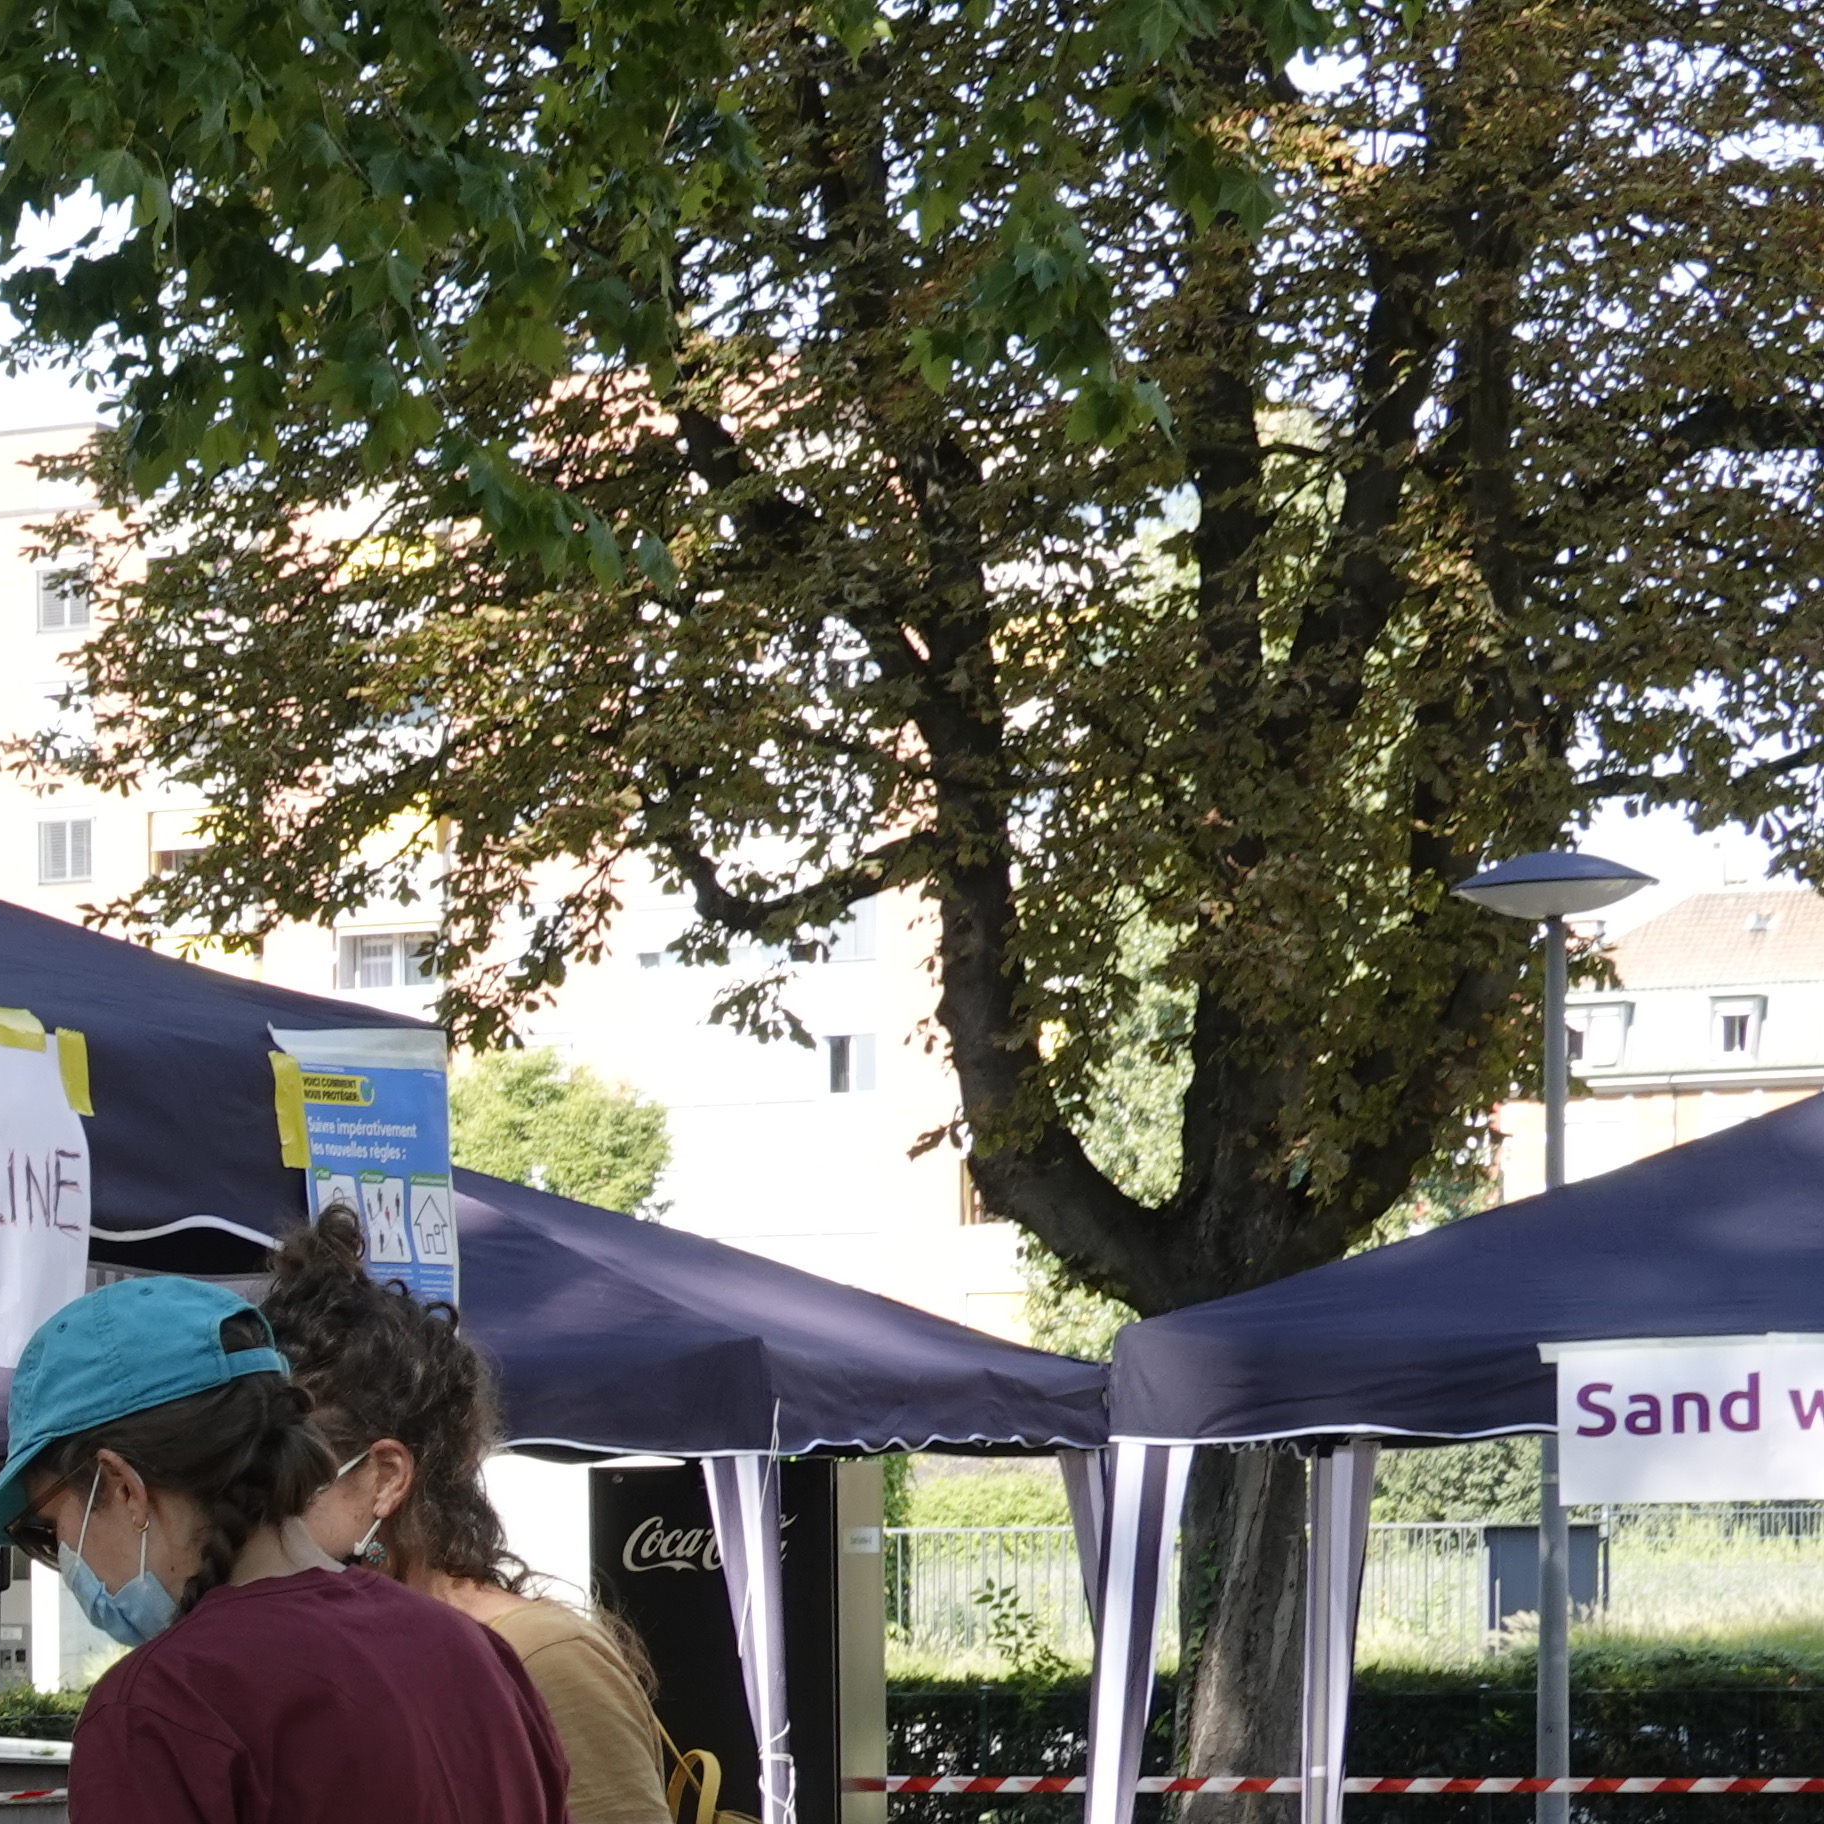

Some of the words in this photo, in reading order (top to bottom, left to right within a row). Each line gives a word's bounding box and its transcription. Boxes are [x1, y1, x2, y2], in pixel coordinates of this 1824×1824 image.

[336, 1117, 417, 1139] impérativement
[325, 1140, 368, 1159] nouvelles
[370, 1141, 400, 1164] règles
[1576, 1371, 1760, 1438] Sand
